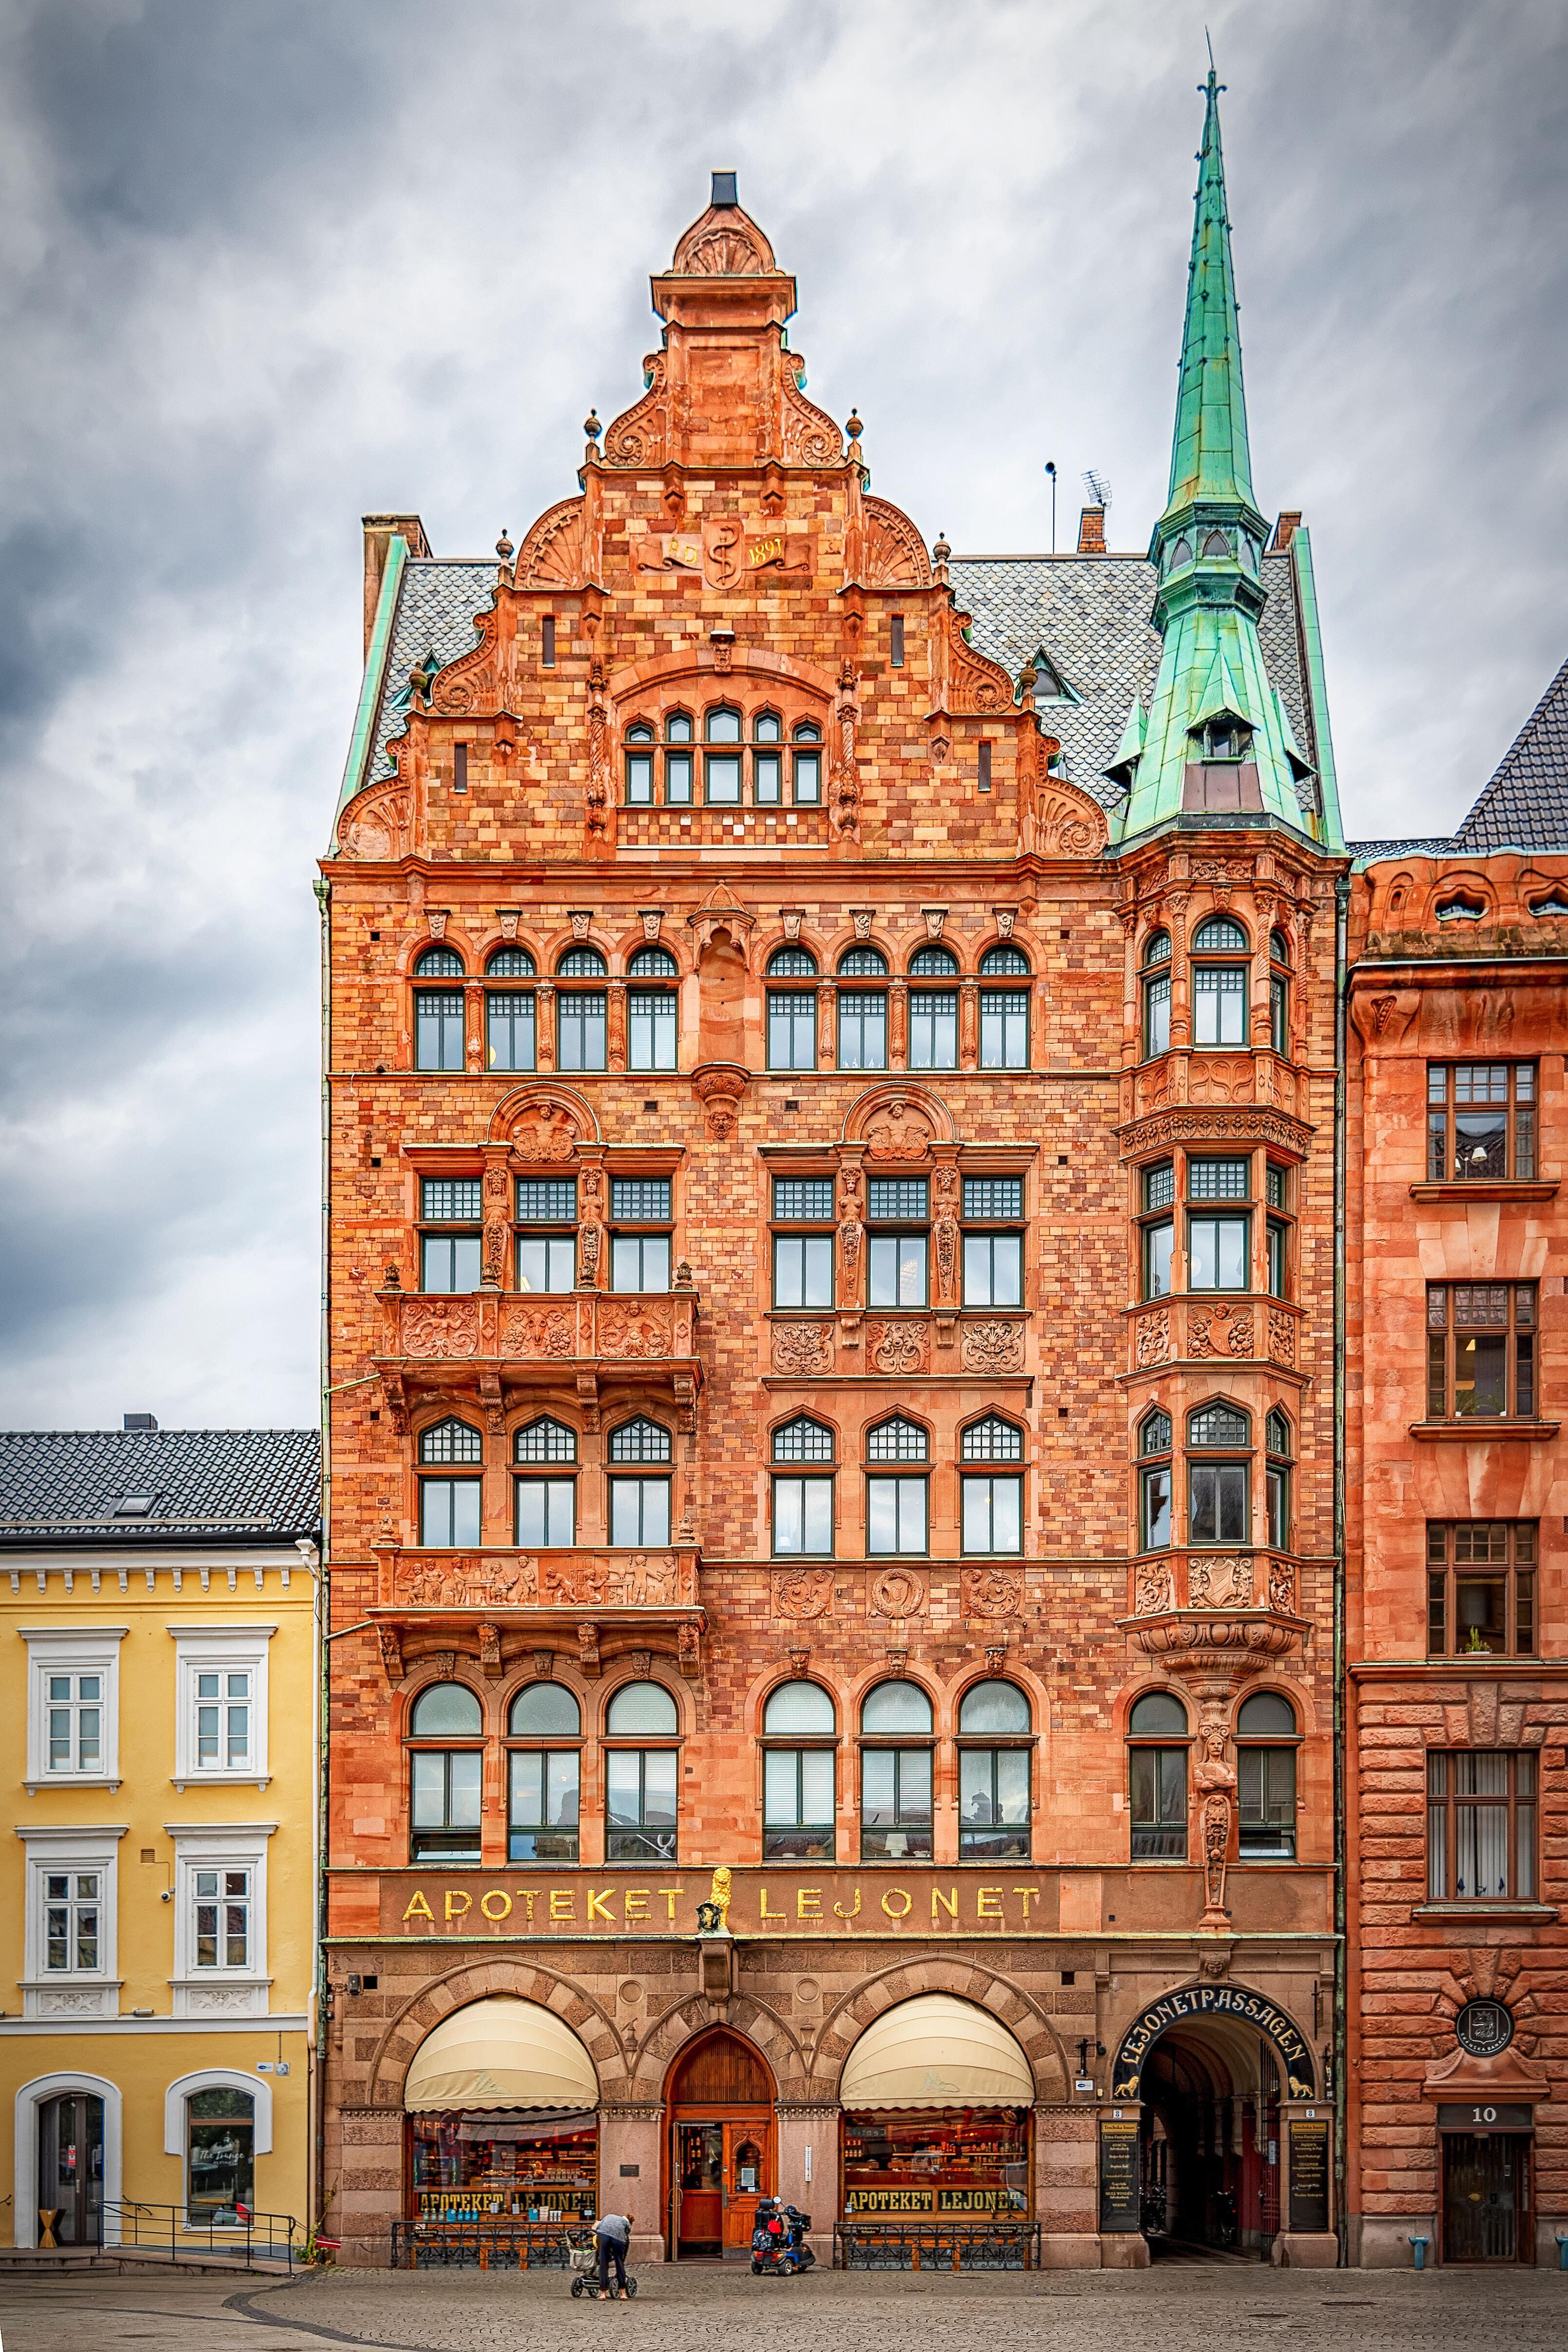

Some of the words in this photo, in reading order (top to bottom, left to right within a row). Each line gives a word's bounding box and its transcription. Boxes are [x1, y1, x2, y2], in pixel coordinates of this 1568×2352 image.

[749, 538, 782, 565] 1891
[401, 1887, 685, 1922] APOTEKET
[759, 1886, 1040, 1919] LEJONET
[1121, 1989, 1306, 2064] LEJONETPASSAGEN
[1472, 2107, 1496, 2122] 10
[420, 2193, 504, 2211] APOTEKET
[849, 2191, 932, 2210] APOTEKET
[941, 2191, 1021, 2210] LEJONET
